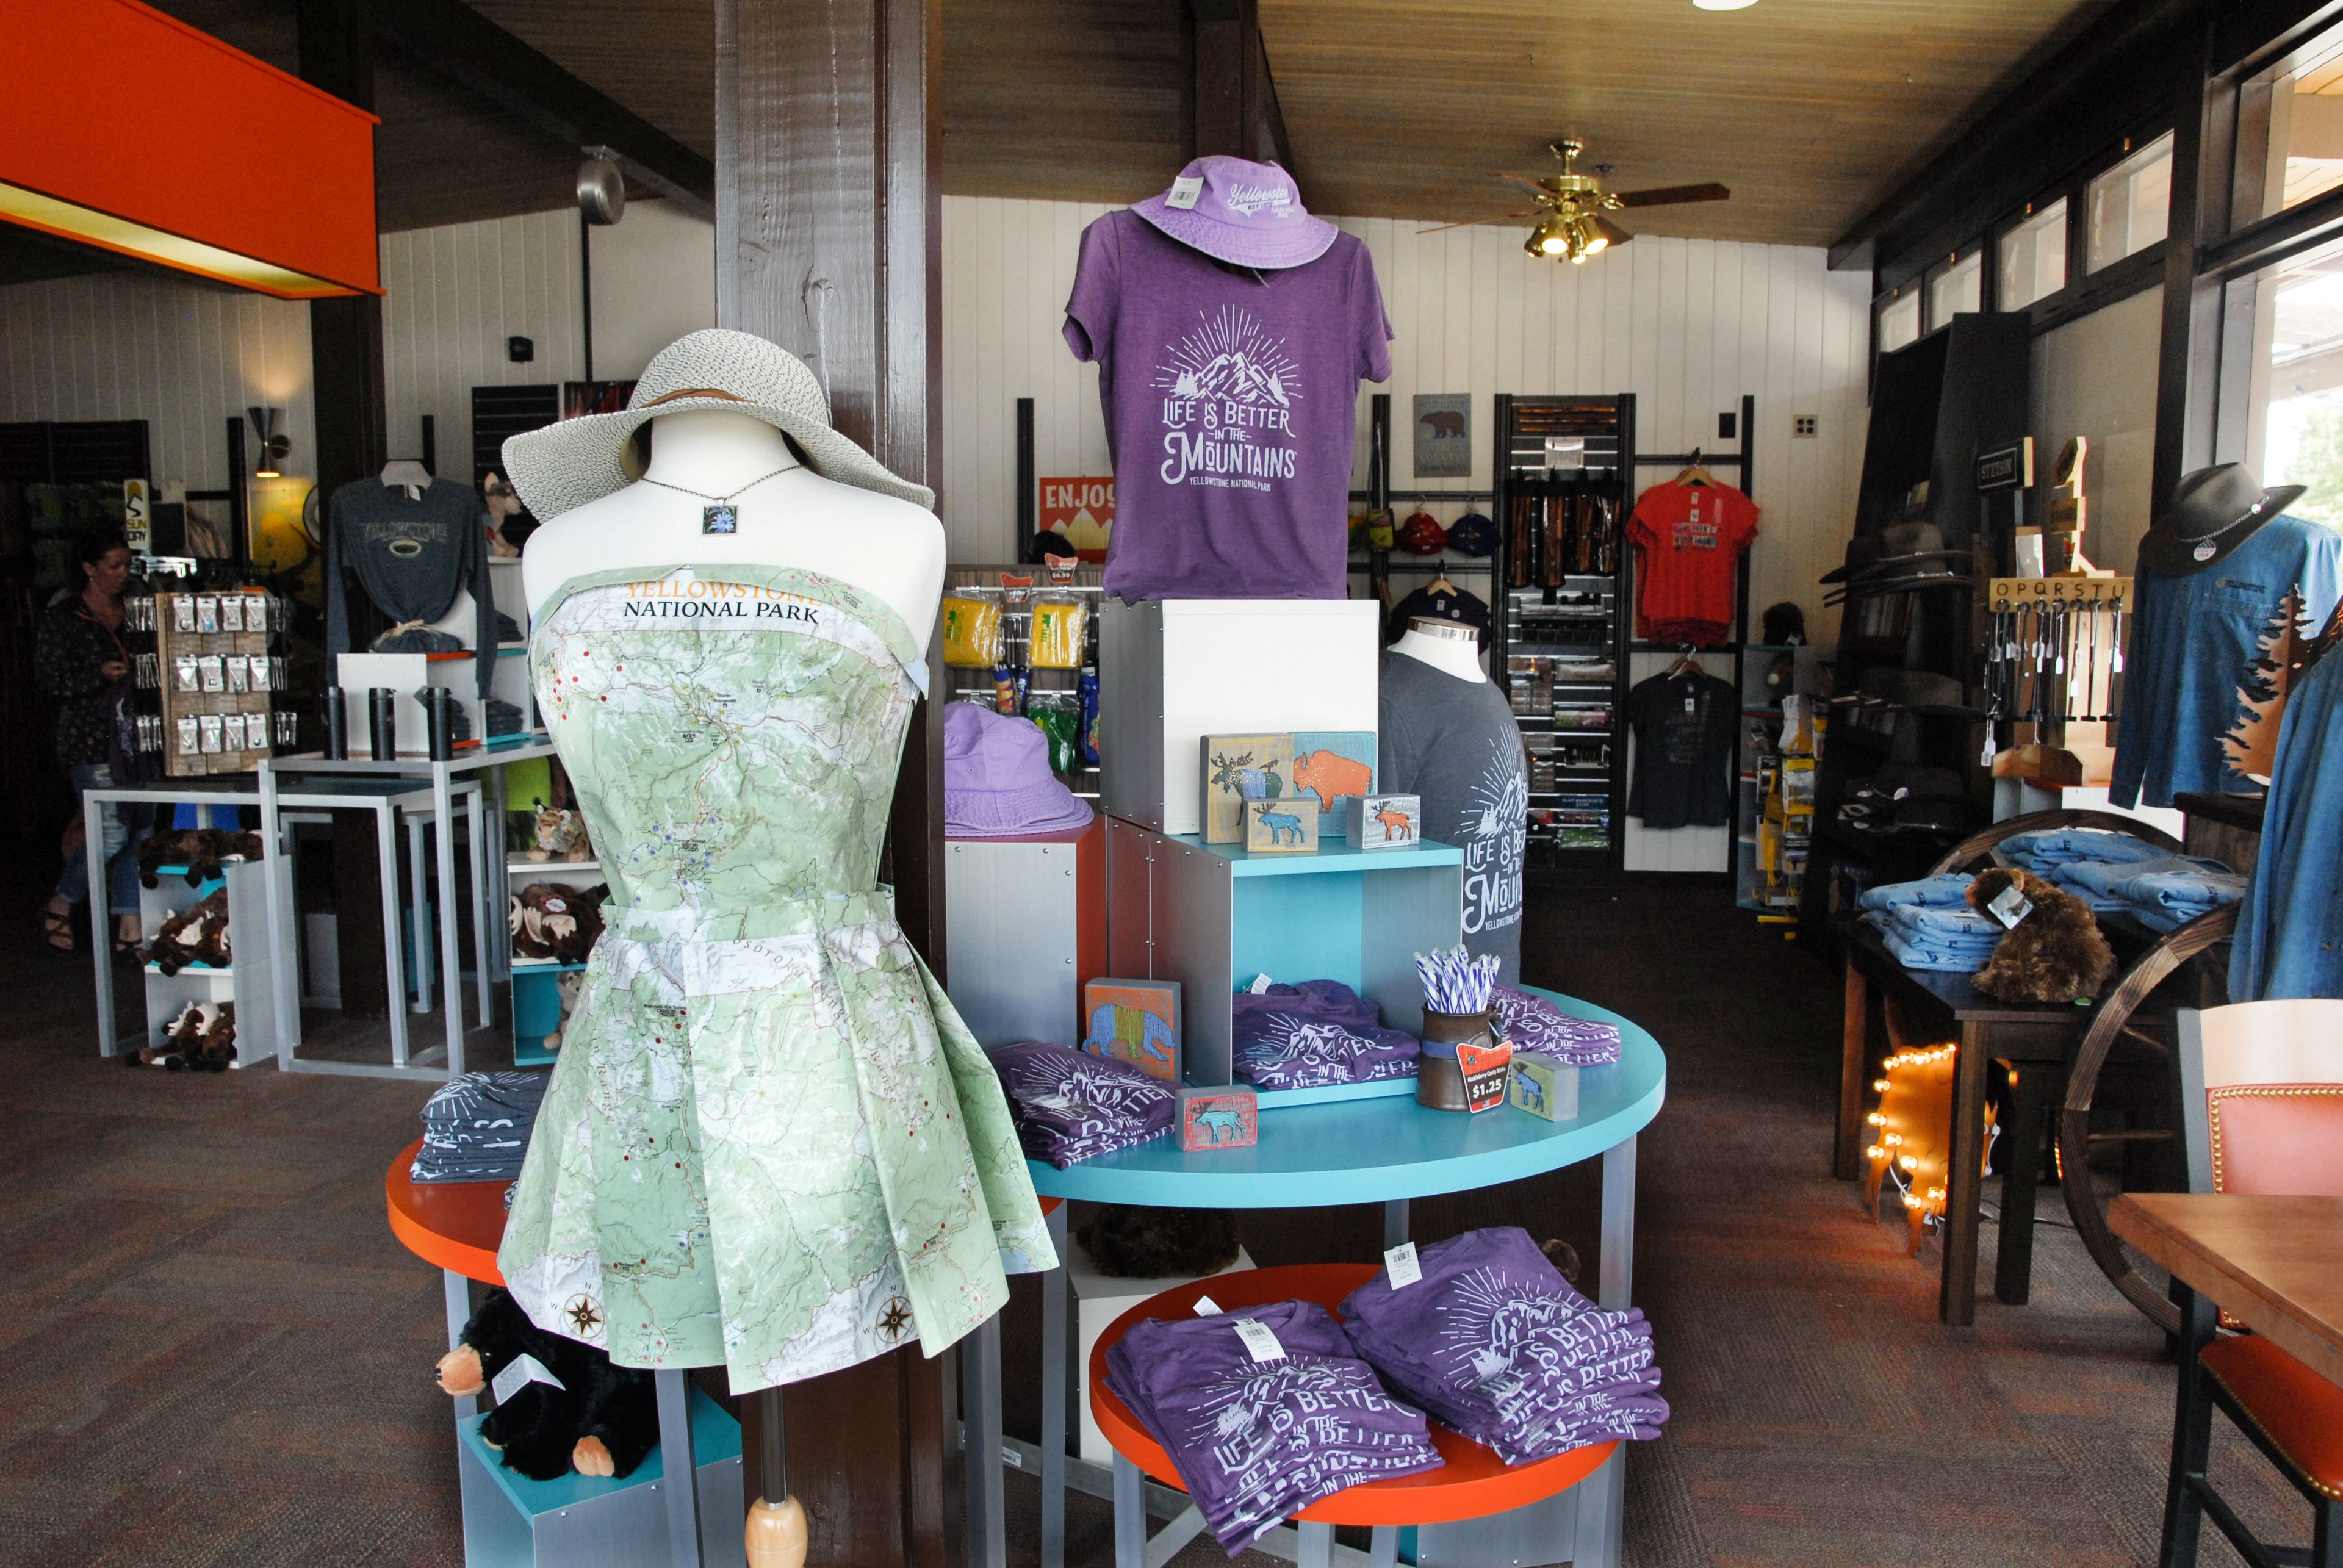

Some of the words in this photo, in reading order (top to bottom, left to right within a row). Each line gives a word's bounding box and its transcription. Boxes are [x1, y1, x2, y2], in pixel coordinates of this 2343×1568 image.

[1162, 398, 1197, 429] LIFE
[1204, 402, 1218, 429] IS
[1225, 401, 1296, 438] BETTER
[1161, 431, 1295, 484] MOUNTAINS
[1981, 458, 2012, 480] STETSON
[1190, 477, 1229, 488] YELLOWSTONE
[1231, 479, 1257, 489] NATIONAL
[1258, 482, 1271, 492] PARK
[1996, 583, 2008, 596] O
[2017, 583, 2026, 595] P
[2034, 582, 2048, 595] Q
[2054, 583, 2063, 595] R
[2075, 583, 2084, 597] S
[2092, 584, 2103, 597] T
[2112, 585, 2125, 598] U
[623, 602, 748, 617] NATIONAL
[755, 602, 819, 625] PARK
[1465, 839, 1495, 872] LIFE
[1500, 835, 1510, 865] IS
[871, 1050, 896, 1103] Range
[1473, 1078, 1502, 1099] $1.25
[1224, 1406, 1247, 1423] X-LARGE
